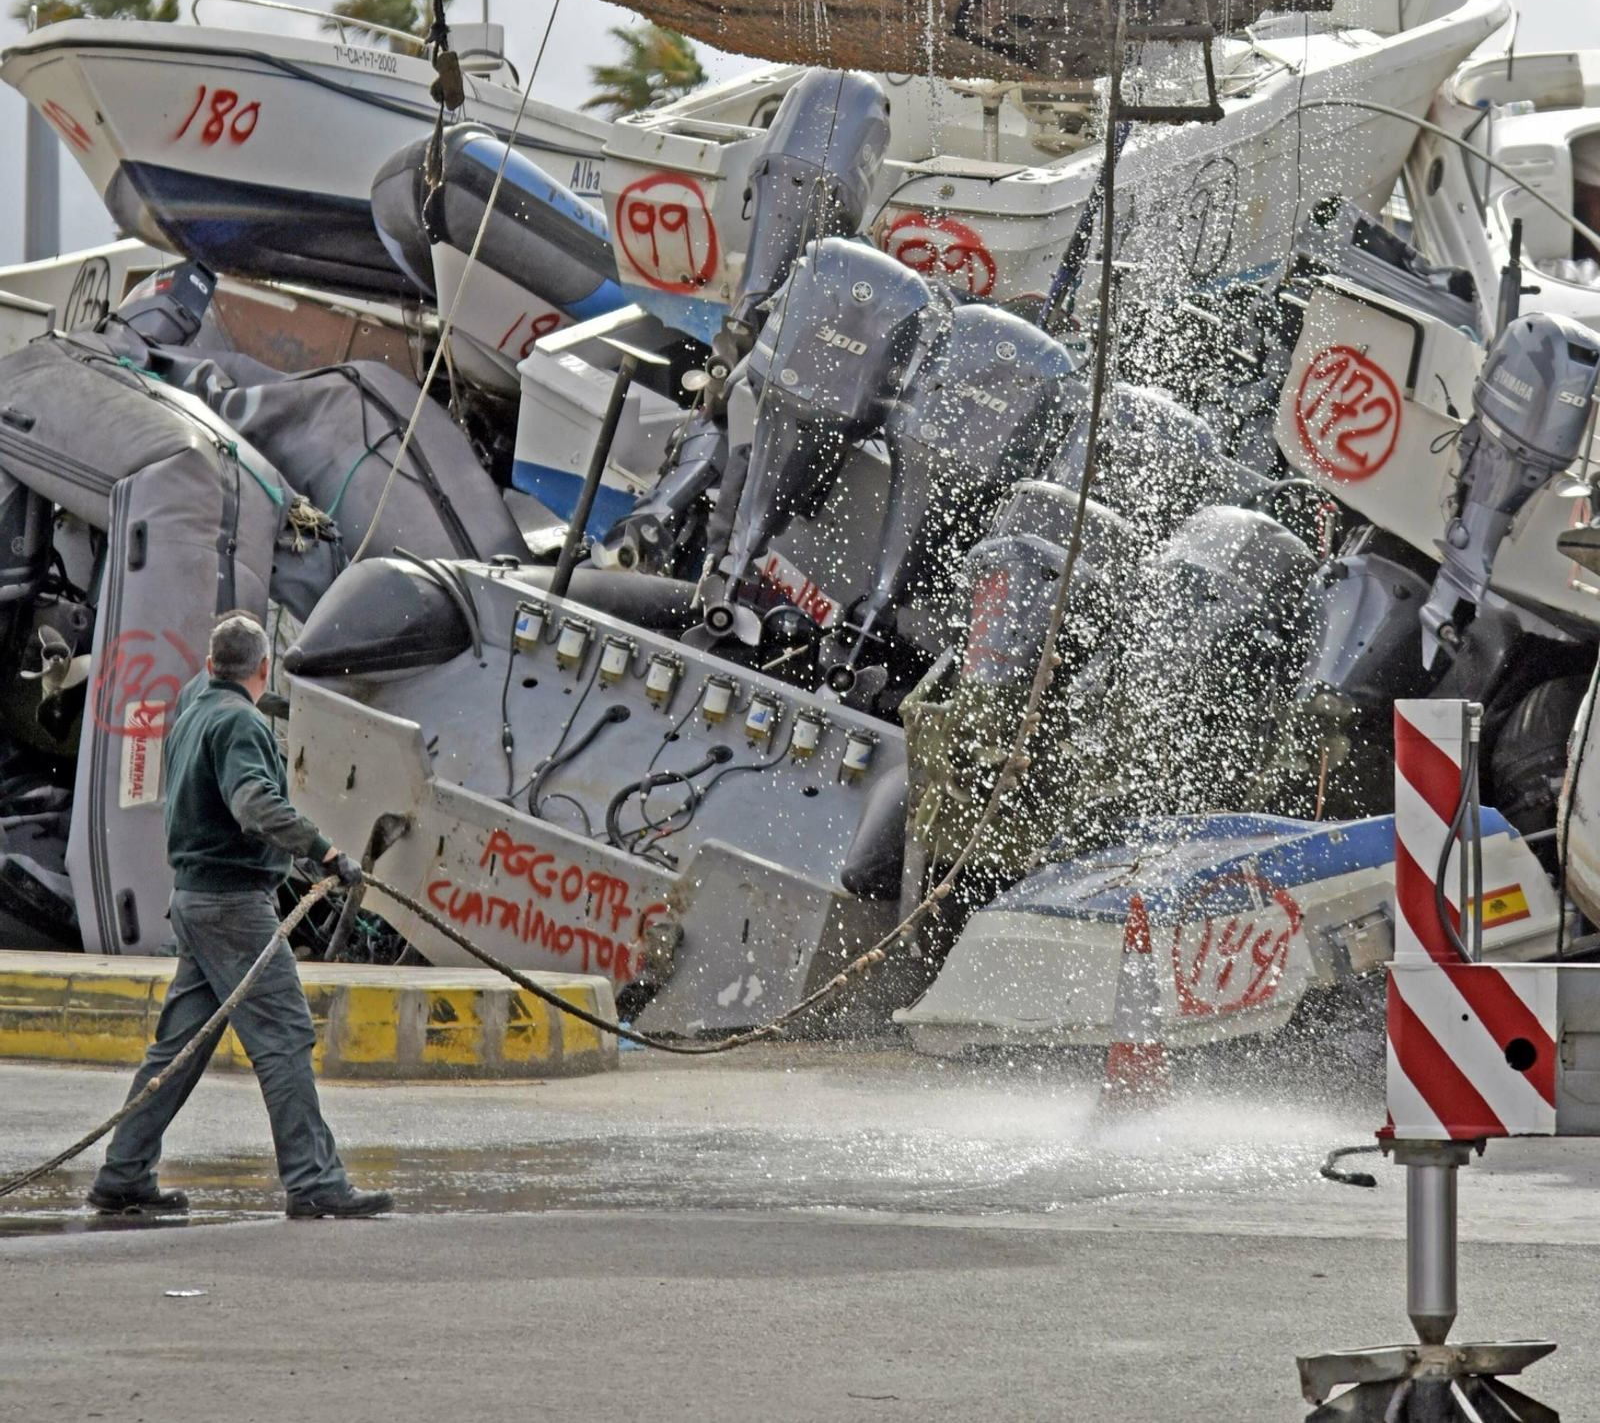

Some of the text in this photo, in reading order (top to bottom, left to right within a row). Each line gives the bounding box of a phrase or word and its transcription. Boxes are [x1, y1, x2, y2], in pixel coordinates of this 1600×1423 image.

[172, 84, 262, 146] 180
[497, 310, 562, 359] 18
[815, 325, 868, 357] 300
[1500, 368, 1535, 402] YAMAHA
[1558, 390, 1588, 409] 50
[1305, 357, 1393, 469] 172
[131, 735, 148, 800] NARWHAL
[427, 879, 646, 982] CUATRIMOTOR
